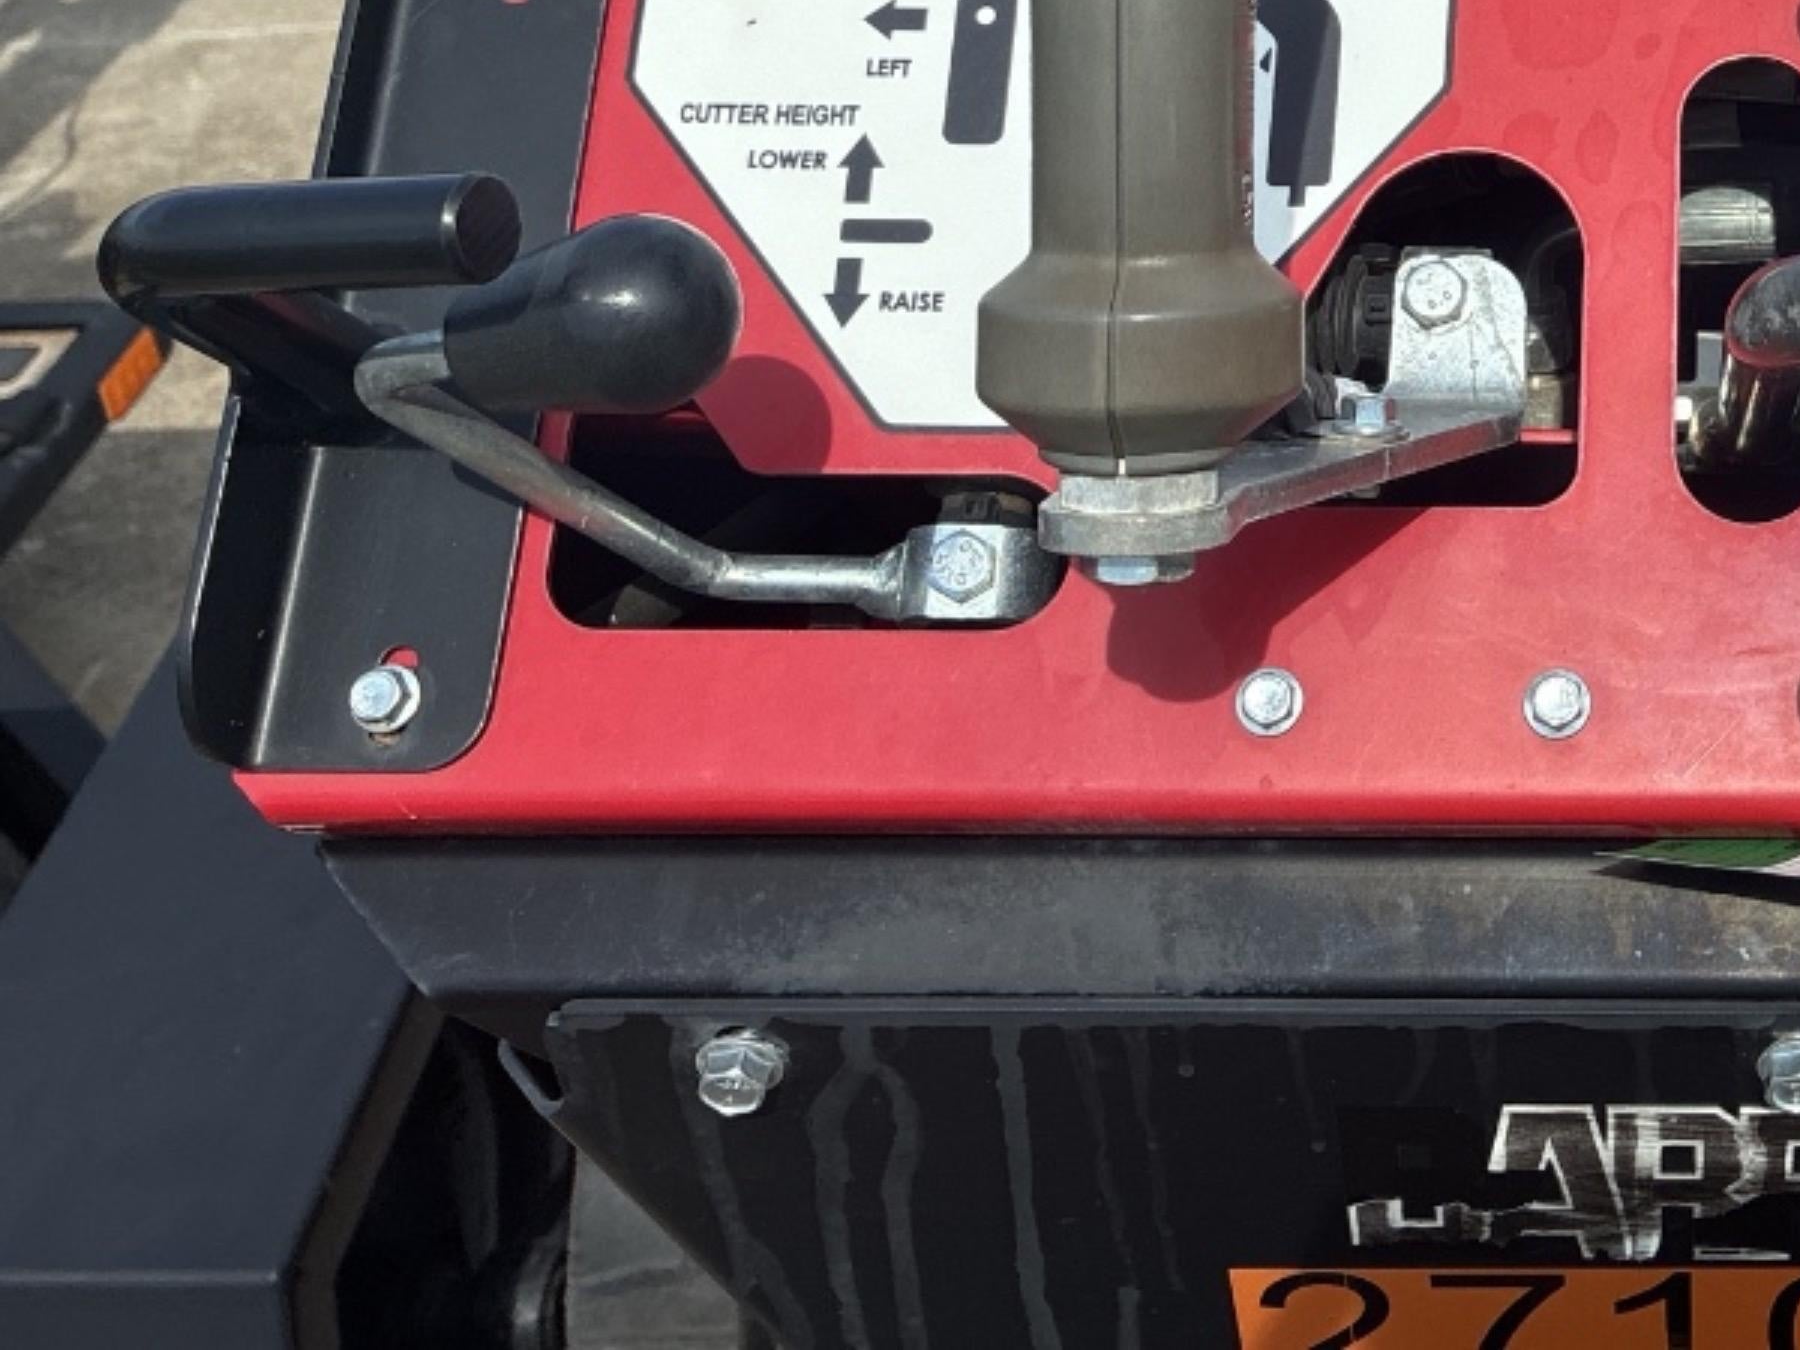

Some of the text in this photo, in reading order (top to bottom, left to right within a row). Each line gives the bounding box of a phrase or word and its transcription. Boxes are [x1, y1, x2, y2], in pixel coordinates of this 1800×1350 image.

[866, 59, 912, 77] LEFT
[680, 103, 860, 126] CUTTER HEIGHT
[747, 149, 827, 170] LOWER
[878, 291, 945, 312] RAISE
